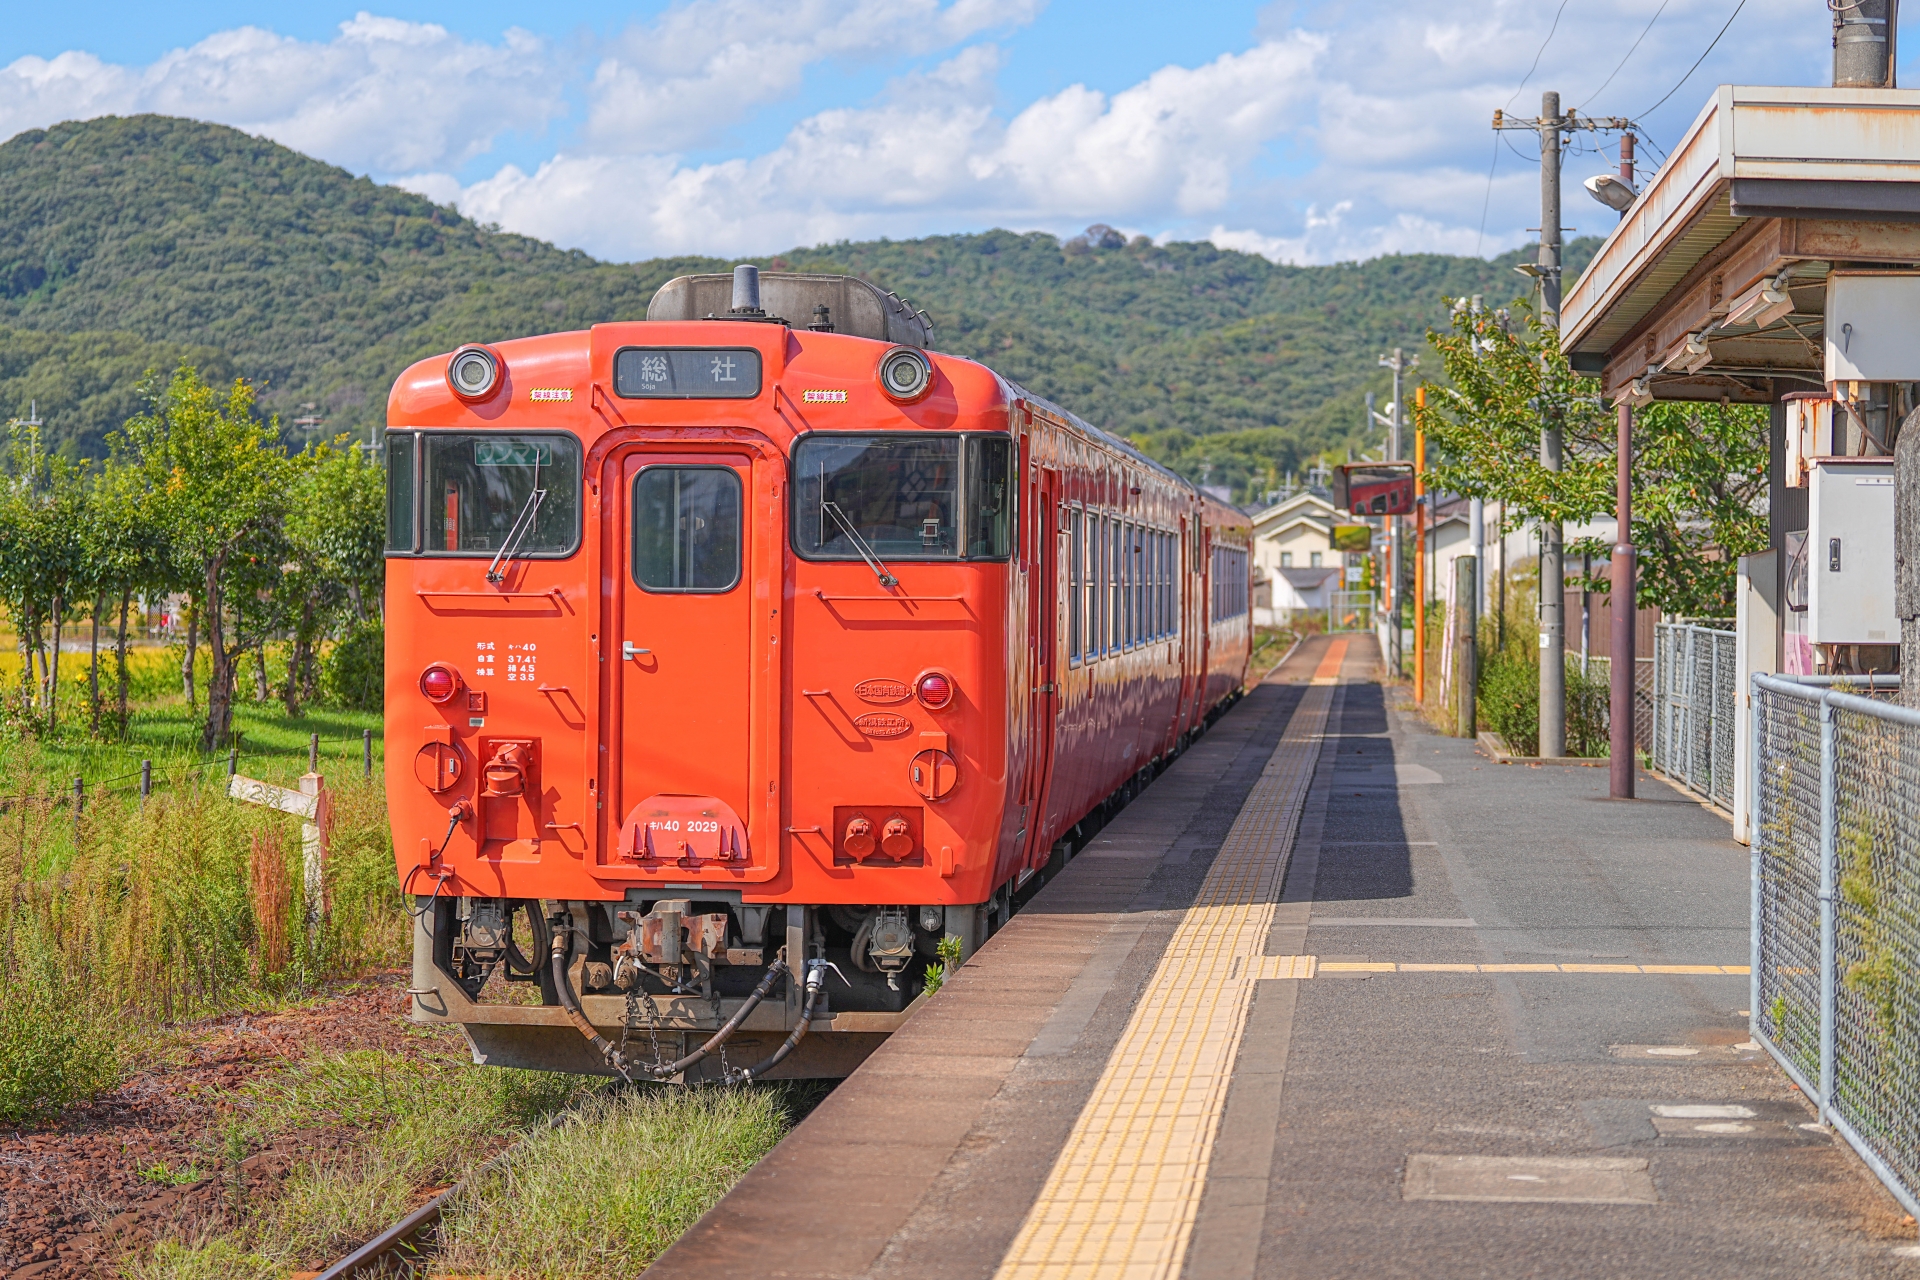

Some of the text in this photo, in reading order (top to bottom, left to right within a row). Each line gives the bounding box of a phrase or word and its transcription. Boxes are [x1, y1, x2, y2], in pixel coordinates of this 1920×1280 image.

[477, 445, 549, 463] ワンマン
[476, 642, 537, 651] 形式 キハ40
[477, 654, 495, 663] 自重
[520, 664, 535, 672] 4.5
[507, 673, 535, 681] 空 3.5
[649, 820, 718, 833] キハ40 2029
